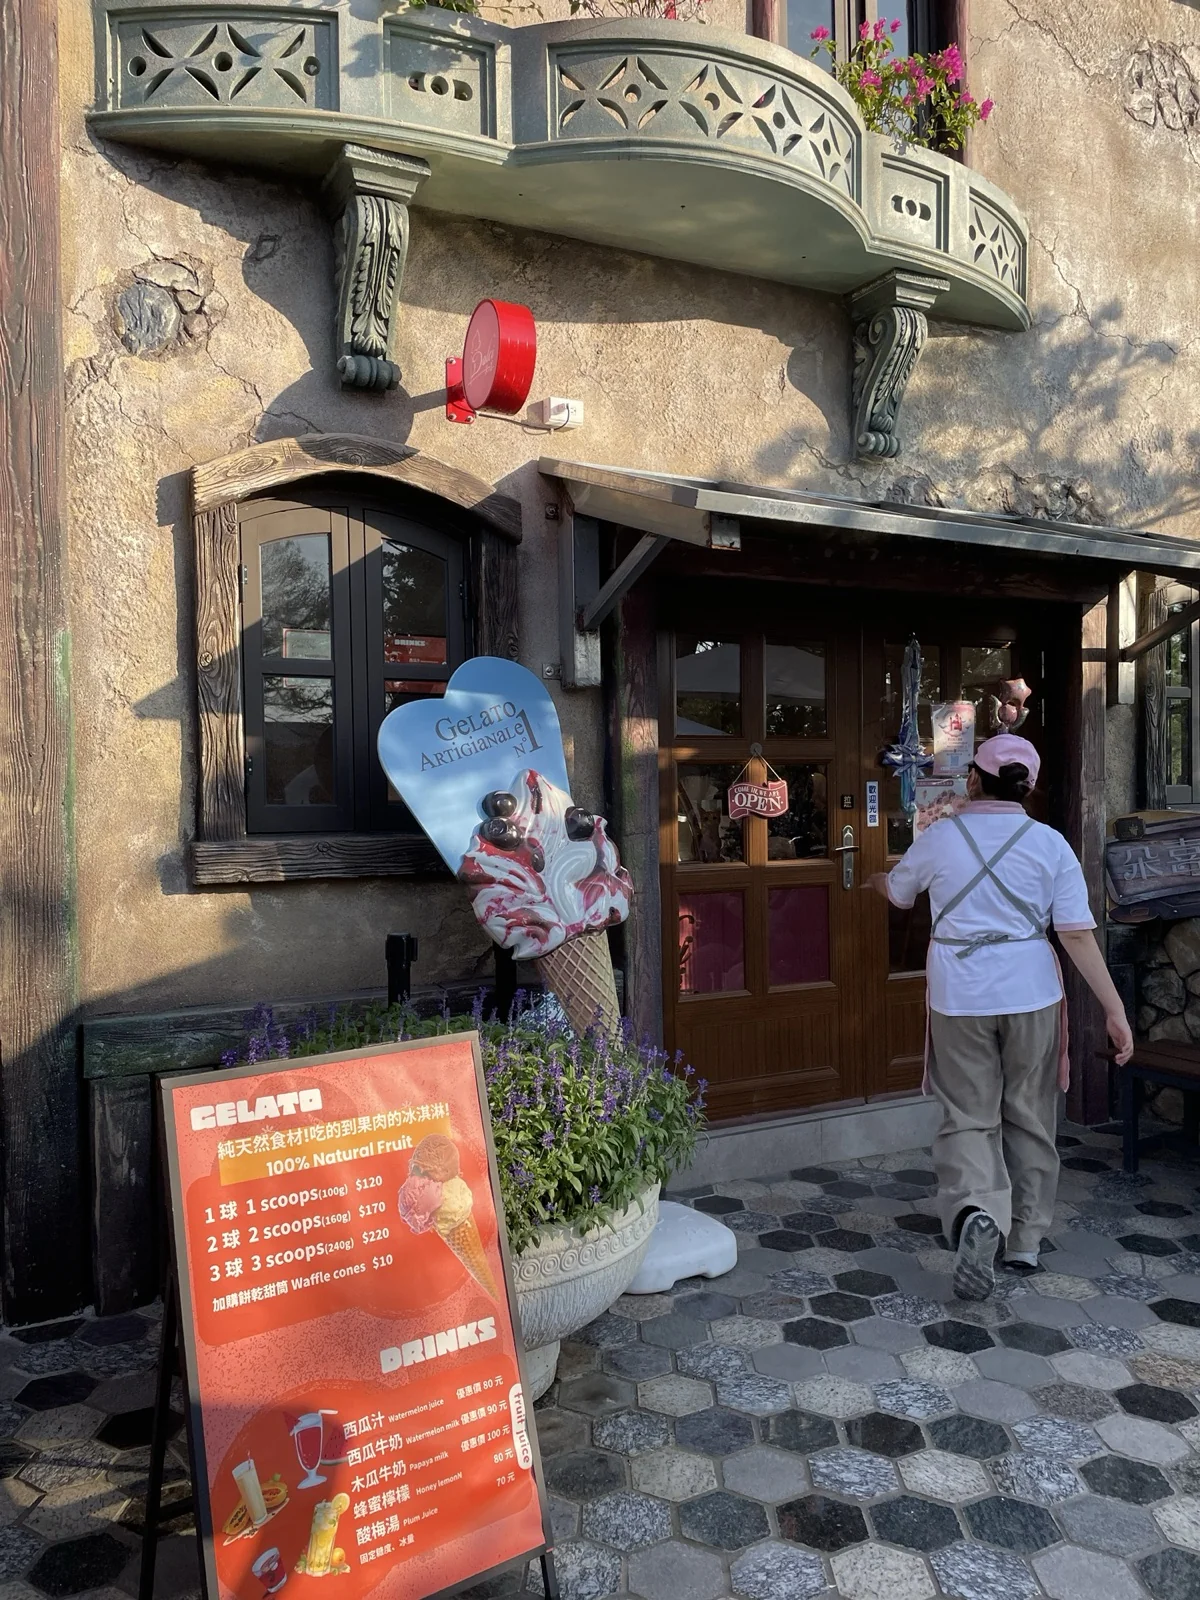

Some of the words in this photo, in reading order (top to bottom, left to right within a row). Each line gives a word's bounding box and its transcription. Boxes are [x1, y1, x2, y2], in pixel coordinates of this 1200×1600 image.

[734, 792, 781, 812] OPEN
[868, 785, 877, 823] 歡迎光臨
[190, 1088, 323, 1131] GELATO
[266, 1155, 310, 1176] 100%
[313, 1142, 374, 1168] Natural
[377, 1135, 413, 1154] Fruit
[205, 1207, 216, 1224] 1
[219, 1201, 238, 1220] 球
[246, 1199, 257, 1215] 1
[355, 1175, 383, 1192] $120
[206, 1236, 218, 1253] 2
[222, 1229, 241, 1249] 球
[248, 1226, 259, 1243] 2
[359, 1201, 386, 1218] $170
[209, 1265, 221, 1282] 3
[225, 1257, 244, 1278] 球
[251, 1255, 262, 1271] 3
[362, 1227, 390, 1244] $220
[212, 1280, 289, 1313] 加購餅乾甜筒
[291, 1271, 331, 1291] Waffle
[333, 1262, 366, 1280] cones
[372, 1254, 394, 1270] $10
[379, 1316, 497, 1374] DRINKS
[342, 1410, 386, 1440] 西瓜汁
[388, 1404, 429, 1423] Watermelon
[428, 1398, 445, 1411] juice
[456, 1382, 482, 1400] 優惠價
[483, 1379, 493, 1390] 80
[494, 1375, 504, 1387] 元
[346, 1433, 403, 1467] 西瓜牛奶
[405, 1425, 445, 1445] Watermelon
[445, 1419, 461, 1430] milk
[460, 1407, 487, 1425] 優惠價
[487, 1403, 498, 1415] 90
[498, 1400, 508, 1411] 元
[350, 1460, 407, 1493] 木瓜牛奶
[409, 1457, 434, 1471] Papaya
[434, 1451, 449, 1461] milk
[460, 1433, 486, 1453] 優惠價
[487, 1428, 501, 1442] 100
[502, 1424, 511, 1436] 元
[516, 1429, 531, 1464] juice
[353, 1484, 411, 1519] 蜂蜜檸檬
[415, 1482, 437, 1496] Honey
[493, 1452, 504, 1464] 80
[505, 1448, 514, 1460] 元
[355, 1514, 400, 1546] 酸梅湯
[403, 1515, 420, 1527] Plum
[421, 1507, 438, 1520] Juice
[496, 1476, 506, 1487] 70
[507, 1471, 516, 1483] 元
